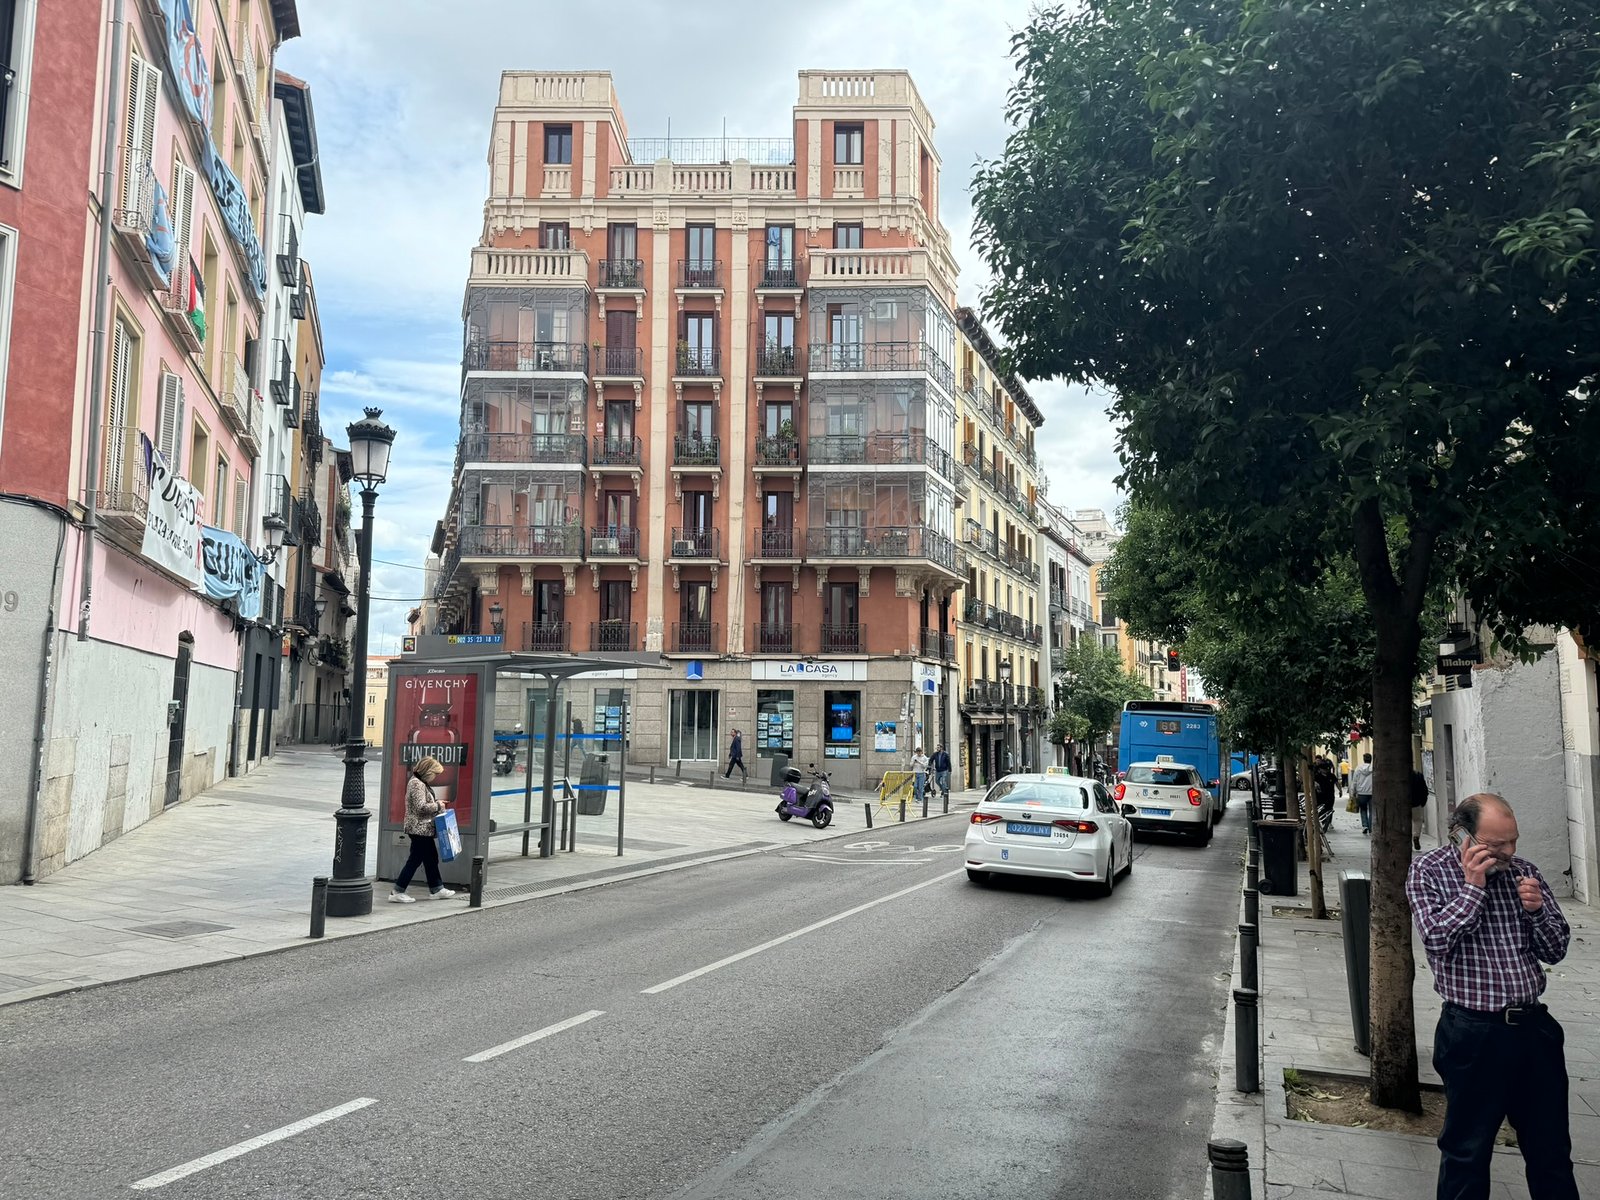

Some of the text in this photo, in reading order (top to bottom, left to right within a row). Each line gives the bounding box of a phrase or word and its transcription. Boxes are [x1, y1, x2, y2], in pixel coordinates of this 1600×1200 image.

[1442, 658, 1477, 667] Mahou
[780, 664, 838, 673] LA CASA
[405, 679, 469, 689] GIVENCHY
[403, 746, 464, 763] L'INTERDIT
[1011, 824, 1050, 835] 0237 LNY
